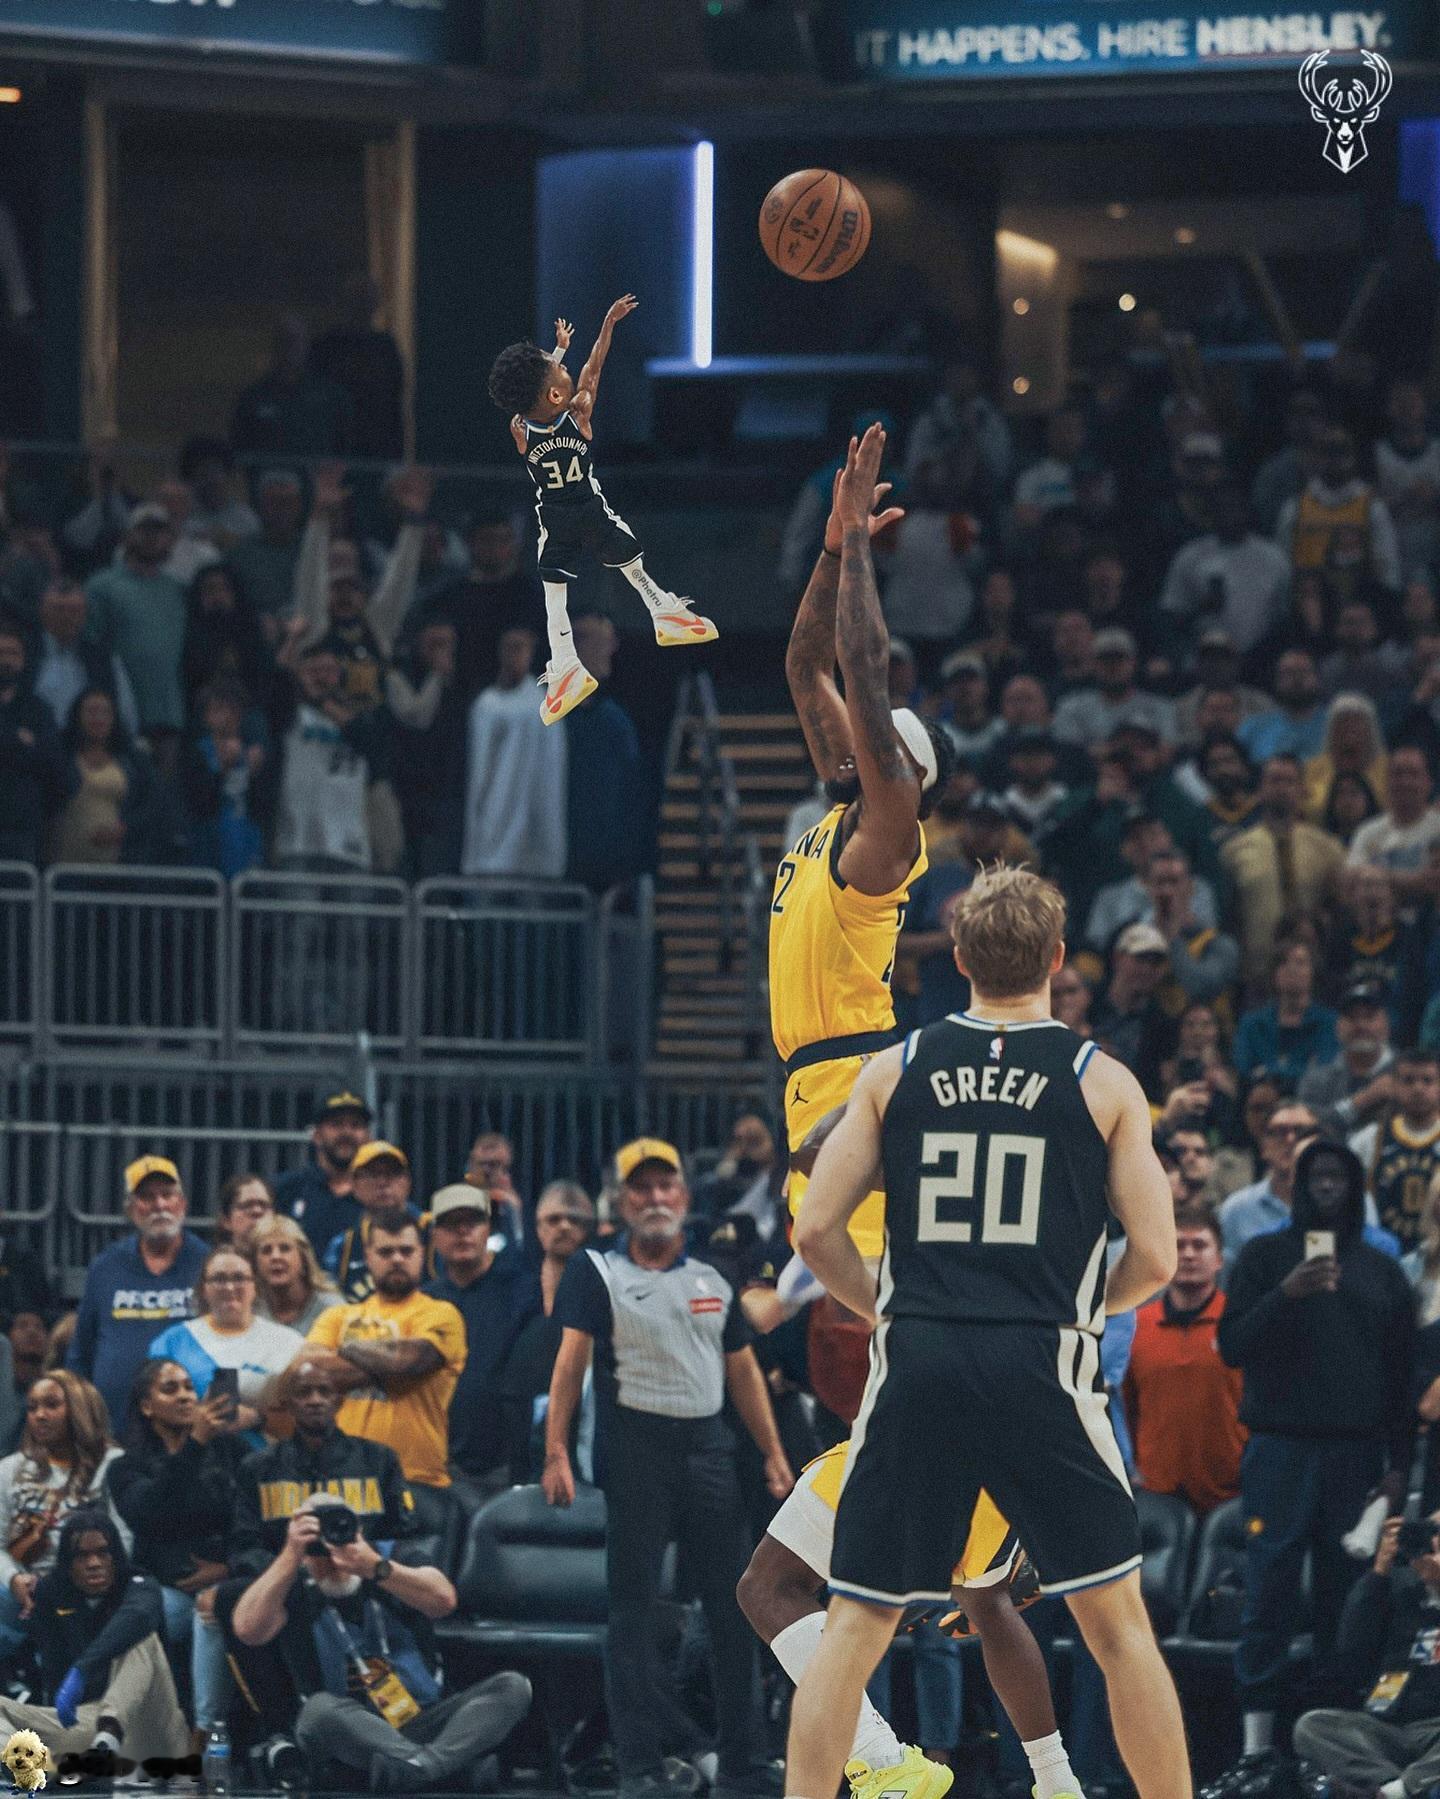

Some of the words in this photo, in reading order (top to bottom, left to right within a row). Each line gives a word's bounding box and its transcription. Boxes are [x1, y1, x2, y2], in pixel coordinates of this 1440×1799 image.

[855, 28, 888, 65] IT
[897, 22, 1091, 65] HAPPENS.
[1098, 17, 1188, 58] HIRE
[1196, 10, 1392, 52] HENSLEY.
[541, 455, 584, 489] 34
[790, 826, 833, 859] NA
[929, 1065, 1049, 1111] GREEN
[917, 1131, 1046, 1245] 20
